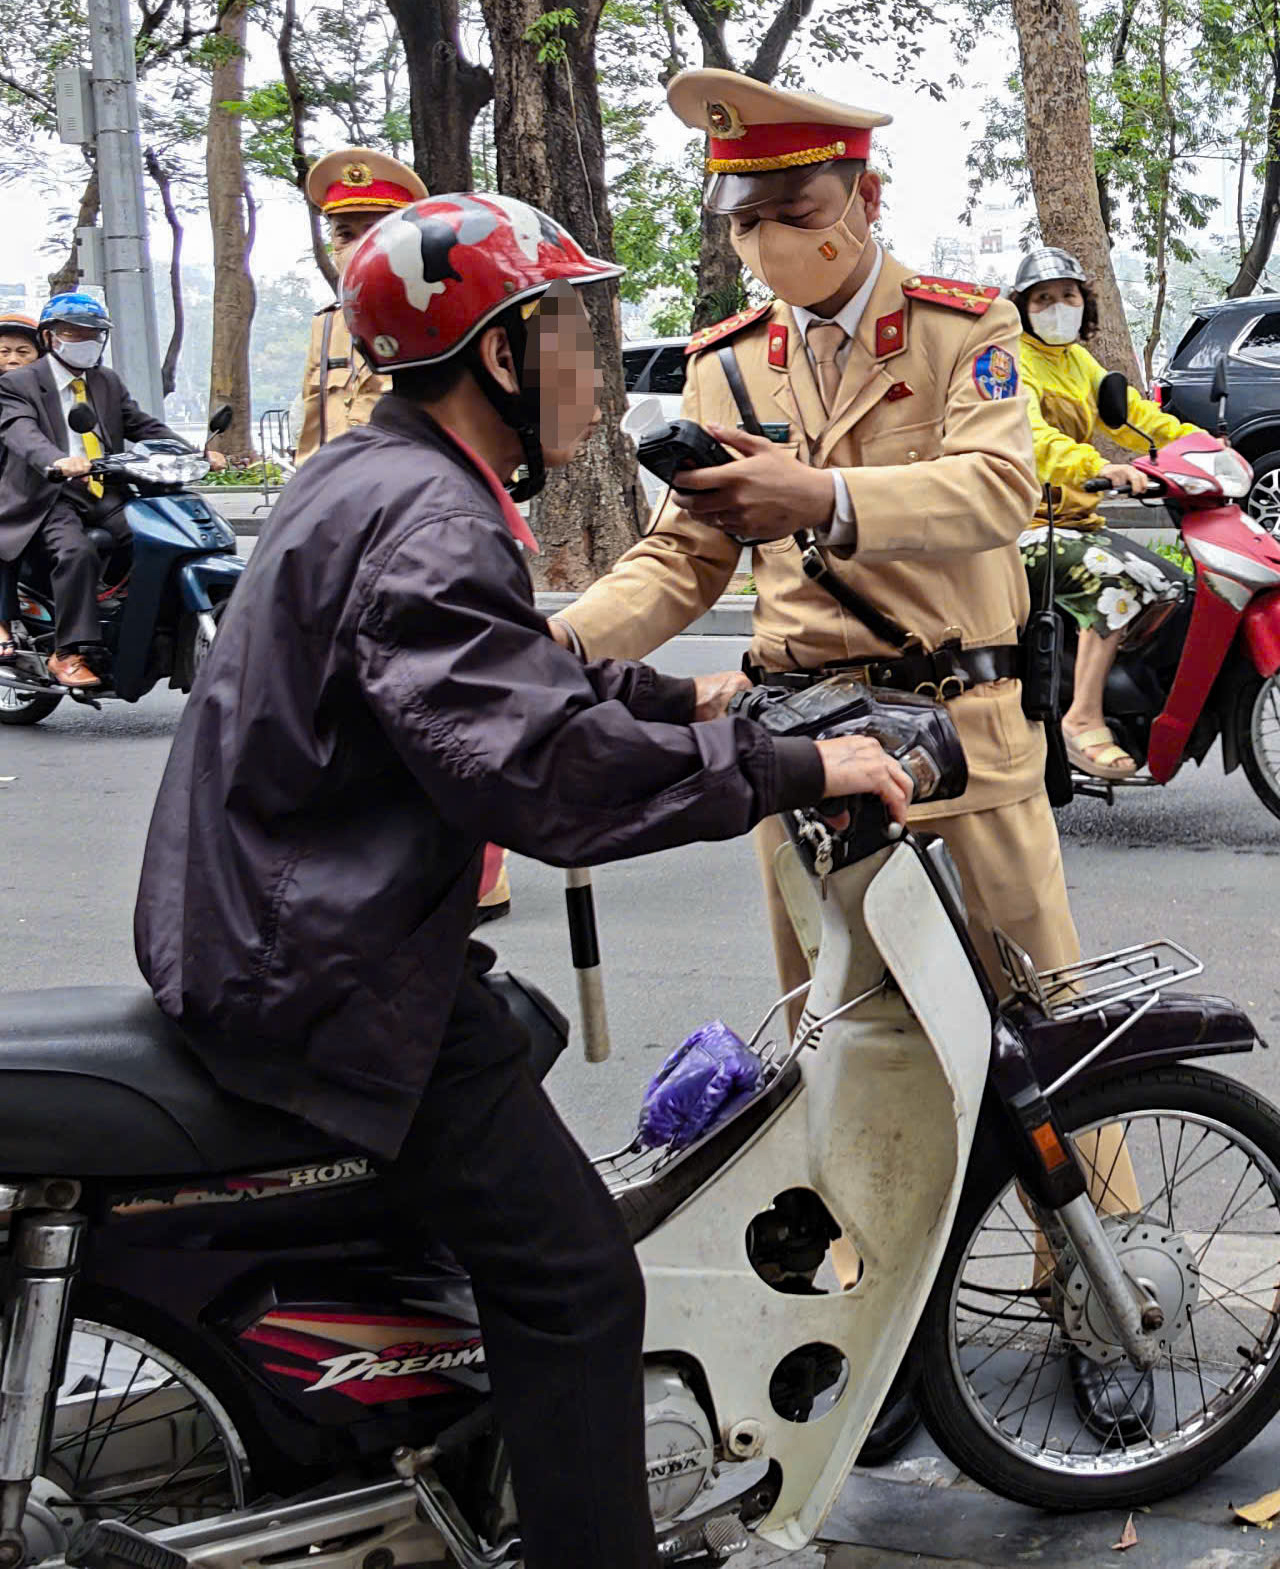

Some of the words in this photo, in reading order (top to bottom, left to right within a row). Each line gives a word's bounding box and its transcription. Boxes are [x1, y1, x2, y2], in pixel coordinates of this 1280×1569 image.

[289, 1158, 368, 1188] HON
[303, 1346, 487, 1392] DREAM
[647, 1458, 699, 1478] NDA
